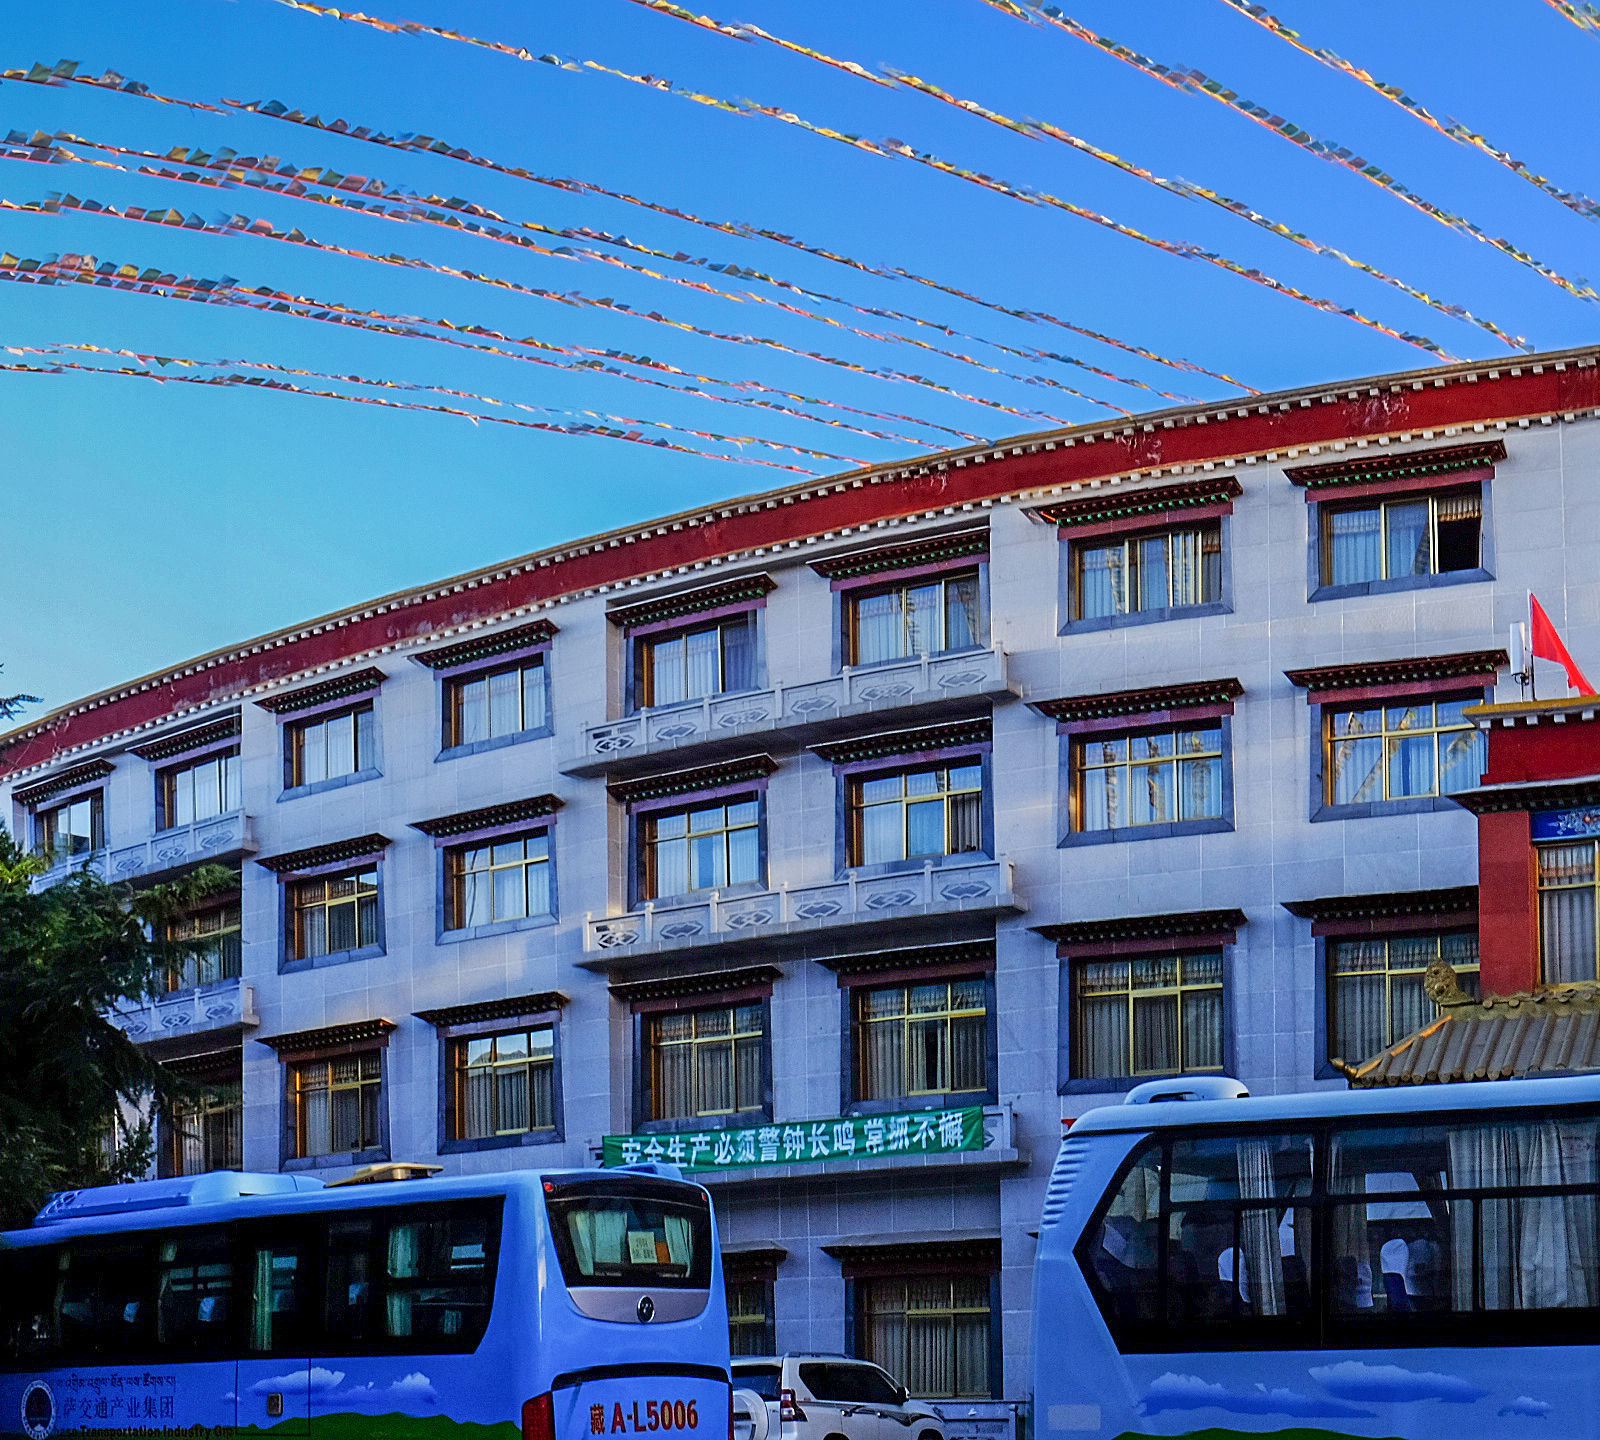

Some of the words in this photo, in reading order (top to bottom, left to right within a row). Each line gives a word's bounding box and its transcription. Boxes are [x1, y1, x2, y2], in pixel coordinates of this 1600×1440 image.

[621, 1120, 856, 1168] 安全生产必须警钟长鸣
[863, 1112, 964, 1154] 常抓不懈
